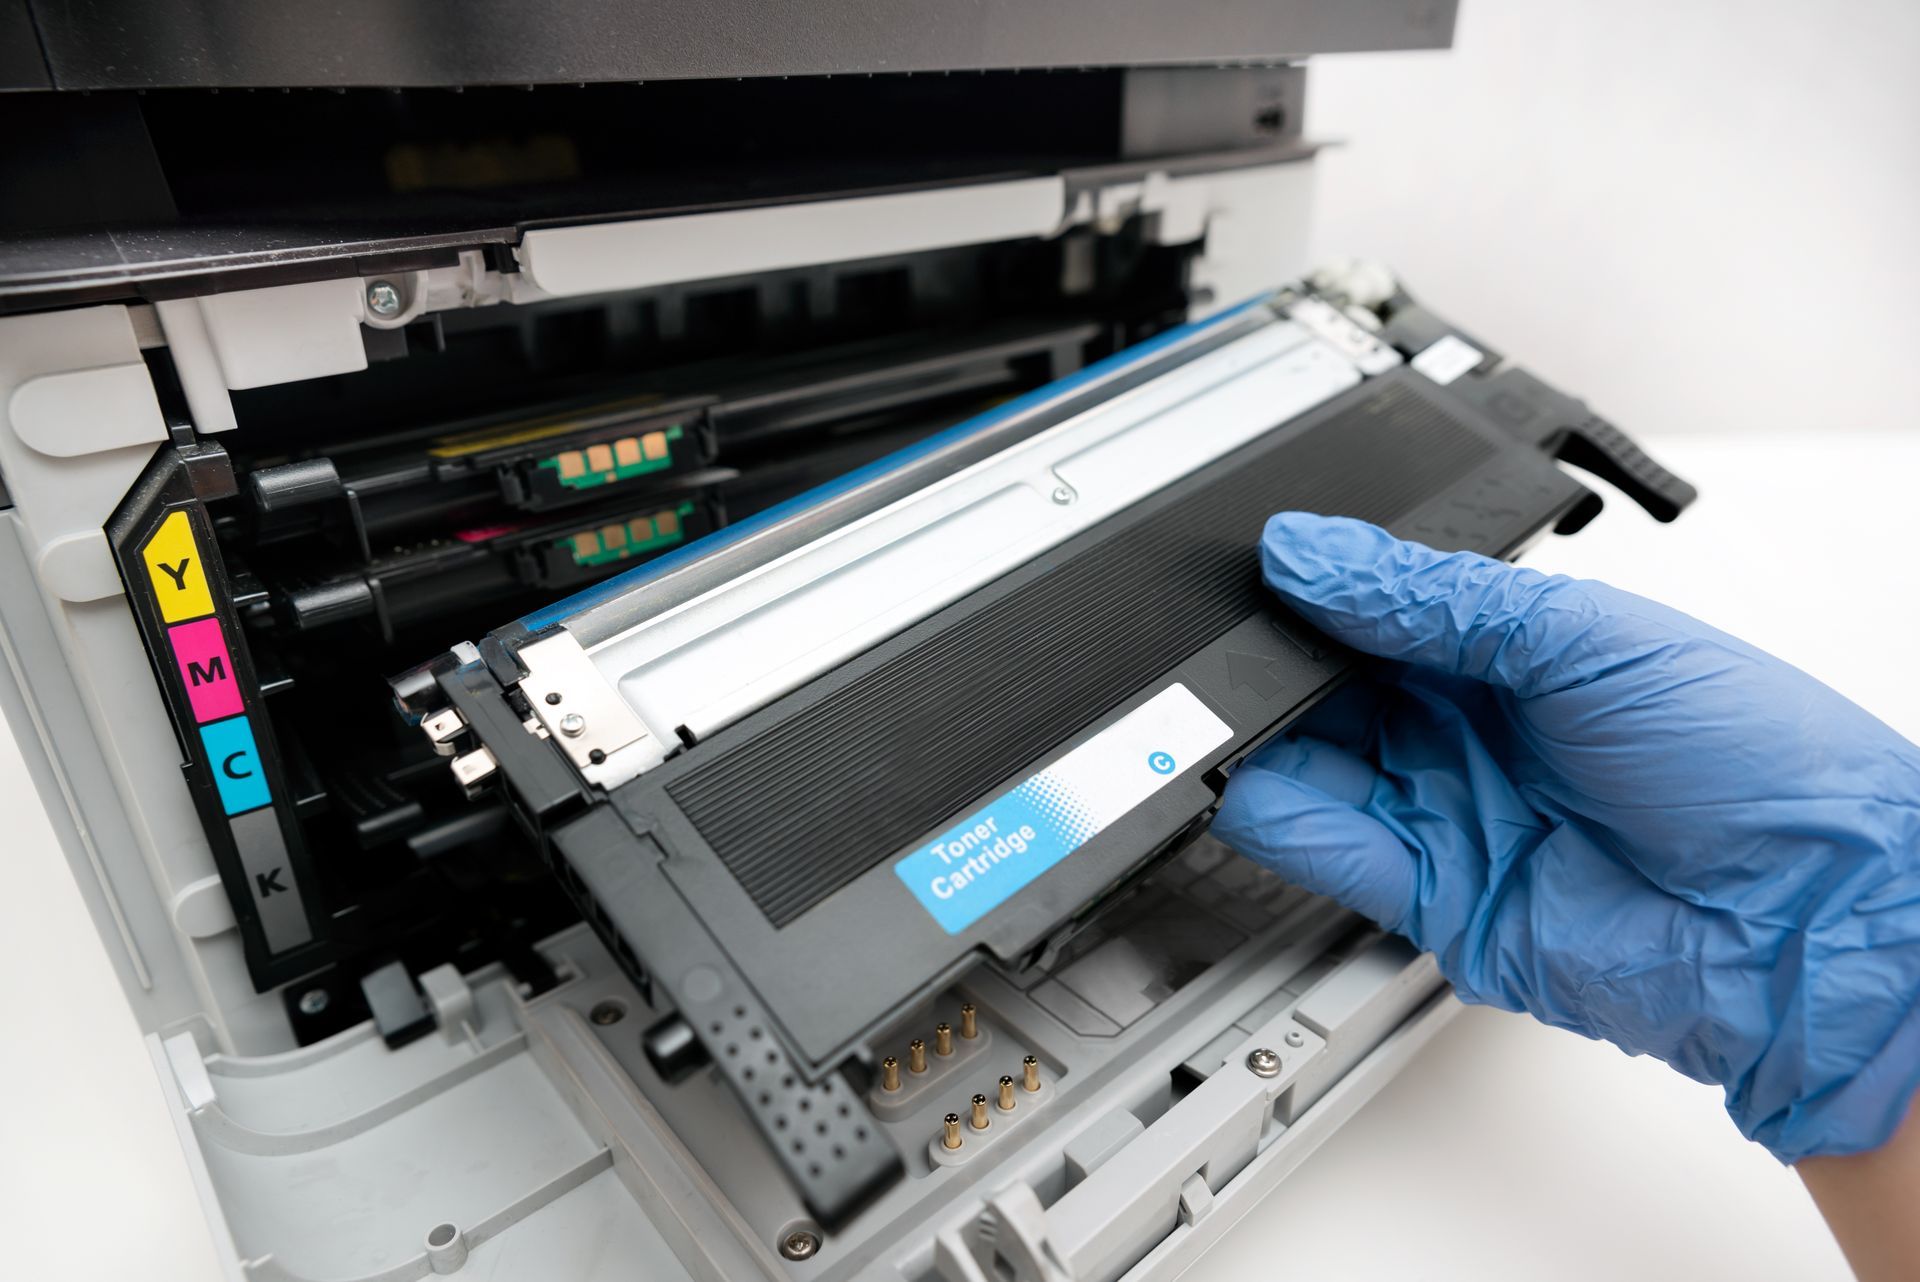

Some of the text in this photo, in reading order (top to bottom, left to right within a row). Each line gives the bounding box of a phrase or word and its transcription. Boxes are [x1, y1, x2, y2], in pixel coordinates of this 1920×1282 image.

[157, 558, 190, 591] Y
[187, 656, 226, 687] M
[222, 751, 253, 780] C
[1153, 755, 1171, 771] C
[930, 816, 998, 865] Toner
[930, 824, 1036, 900] Cartridge
[255, 867, 289, 899] K
